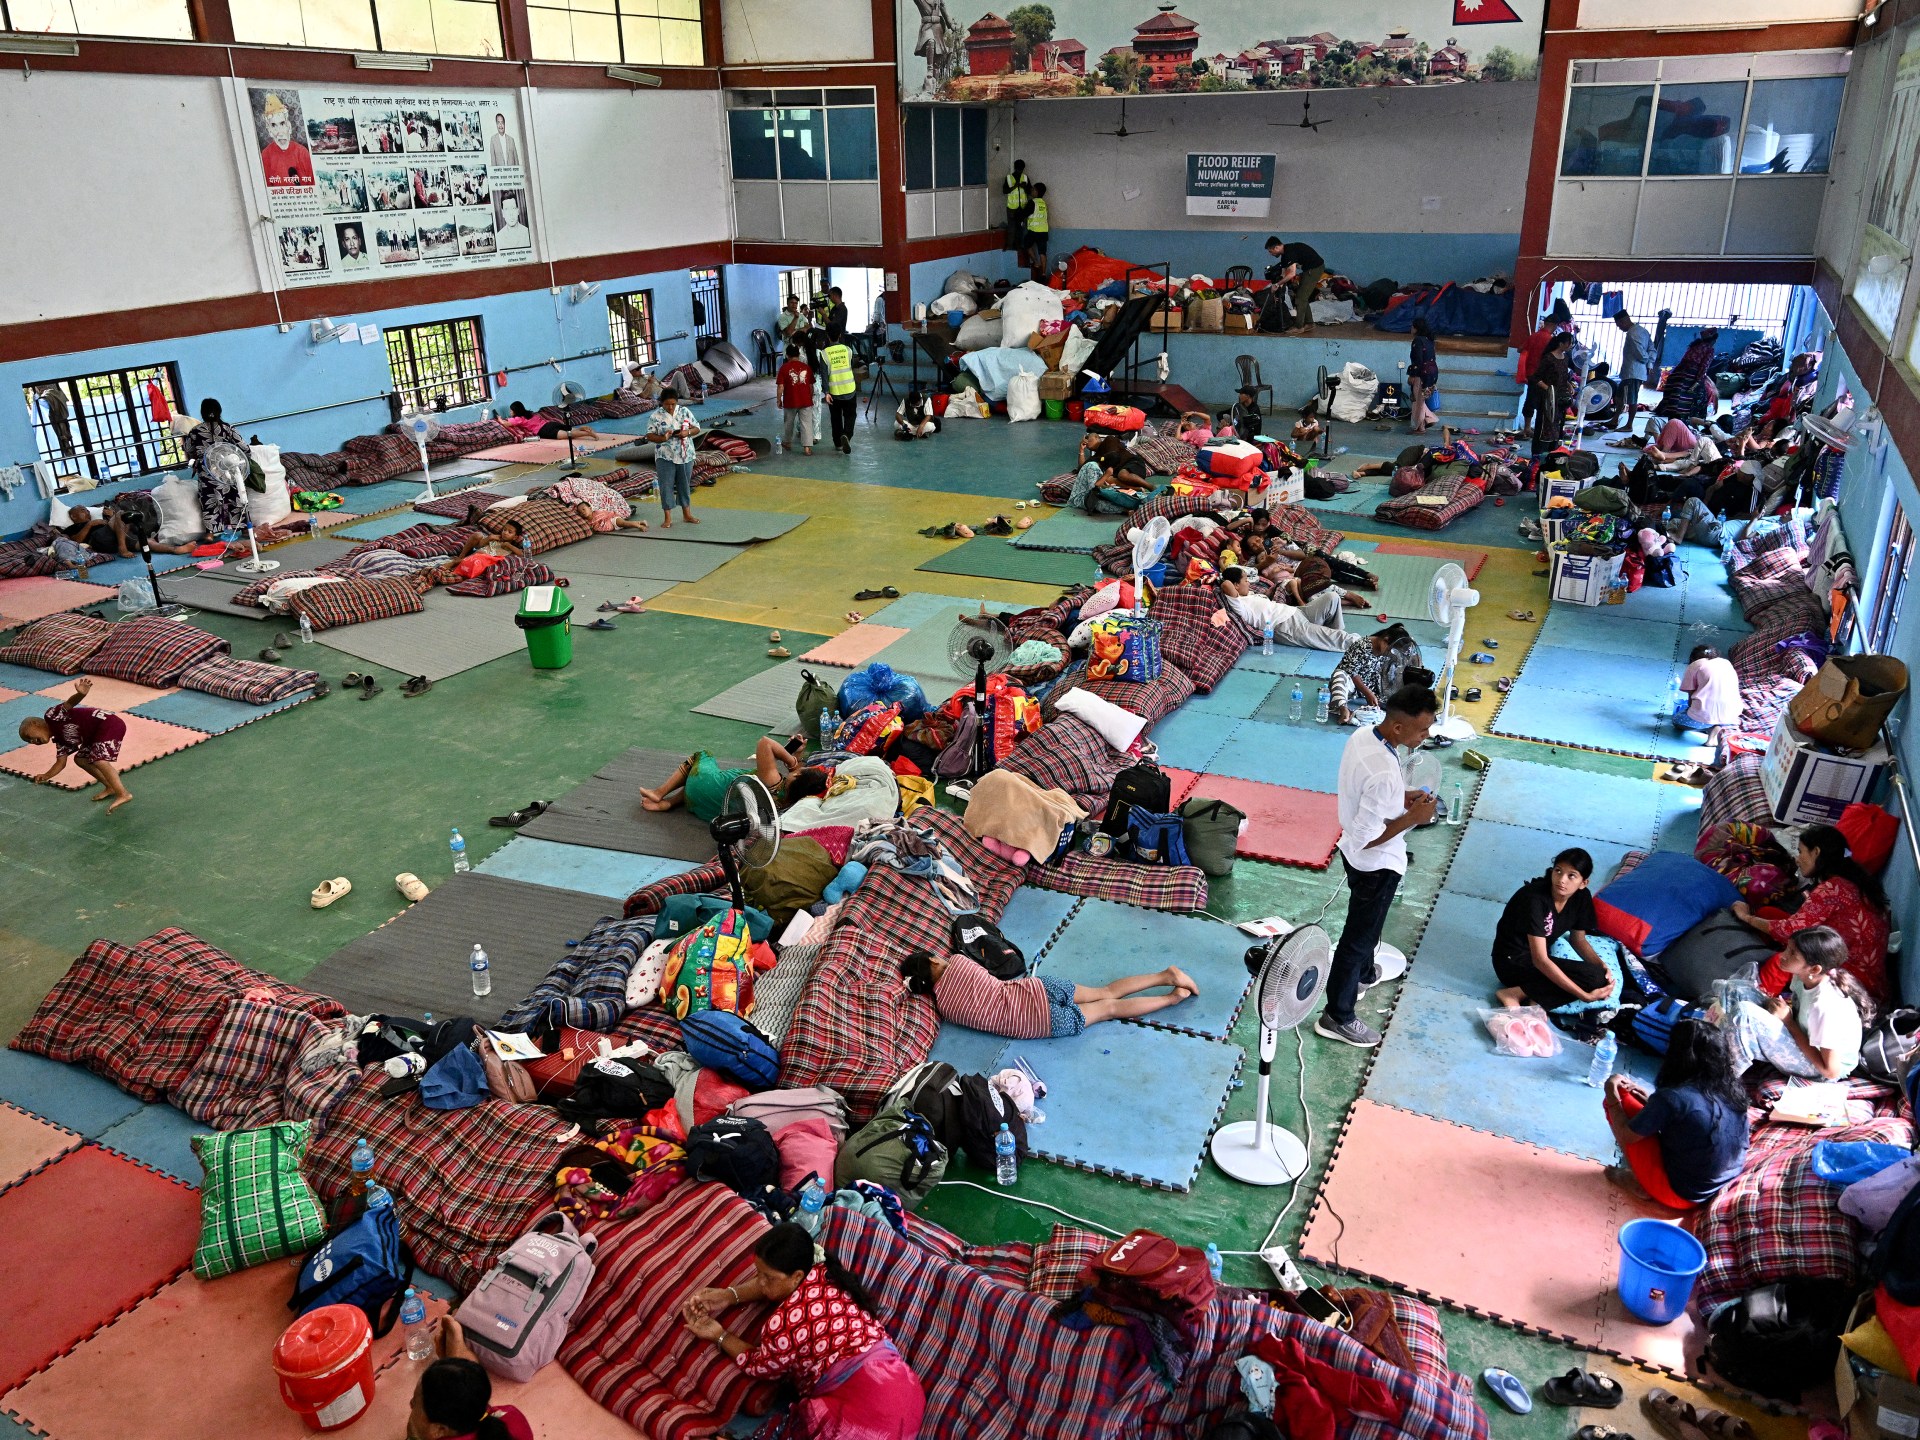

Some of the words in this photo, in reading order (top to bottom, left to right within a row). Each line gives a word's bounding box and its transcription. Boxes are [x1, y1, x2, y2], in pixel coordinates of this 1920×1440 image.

[1198, 156, 1229, 168] FLOOD
[1231, 157, 1261, 168] RELIEF
[1198, 171, 1239, 180] NUWAKOT
[495, 1313, 518, 1328] FASHION
[496, 1322, 510, 1331] BAG
